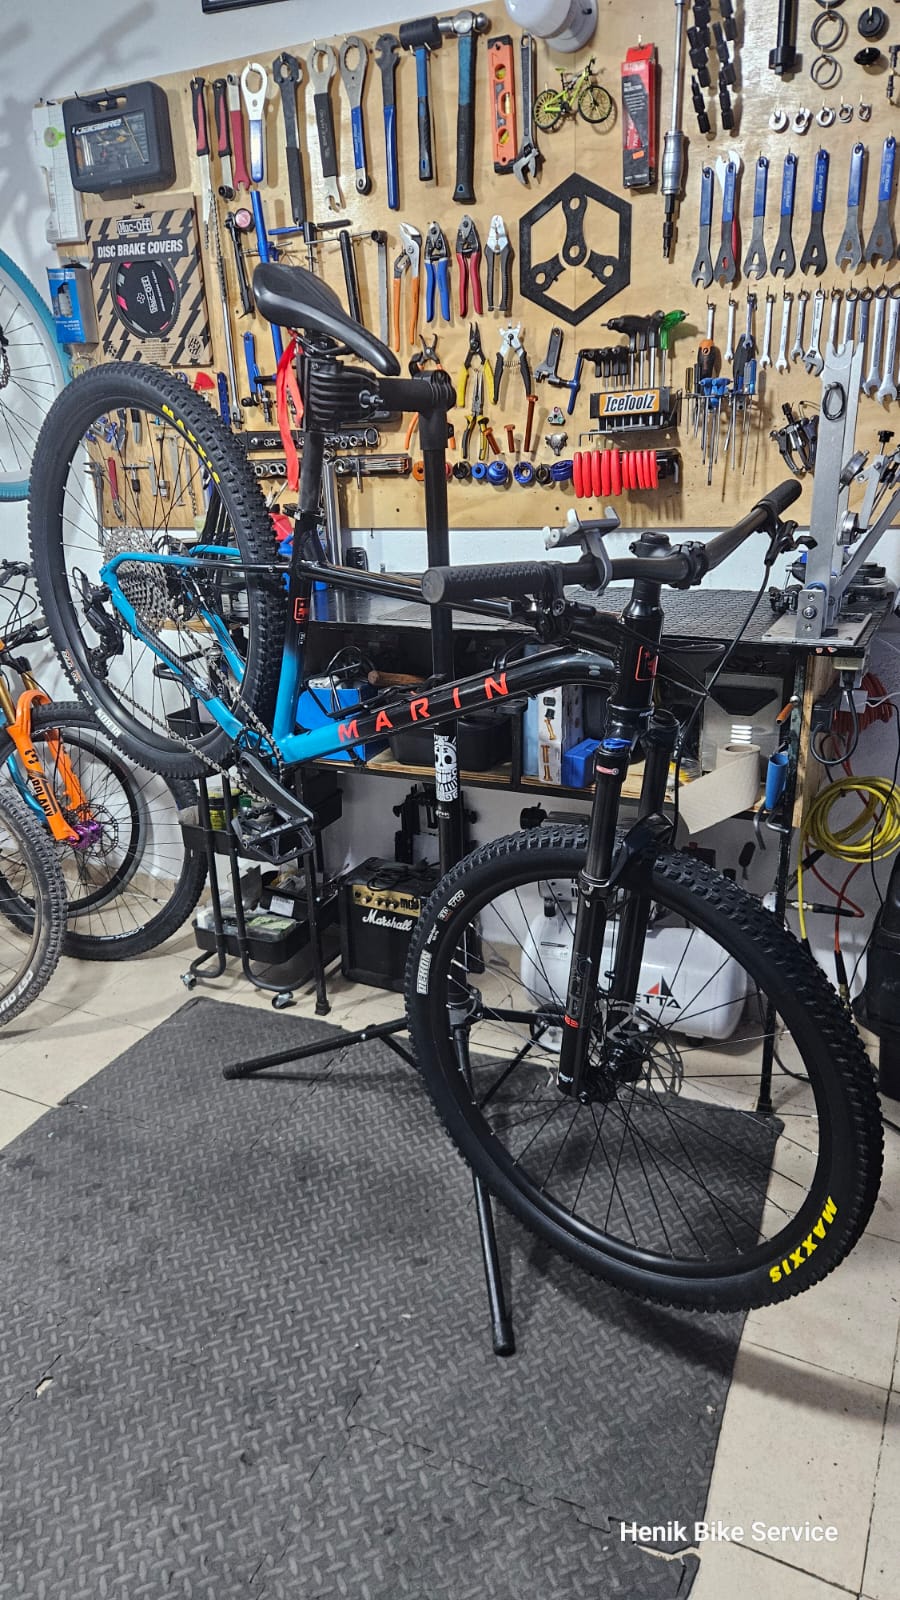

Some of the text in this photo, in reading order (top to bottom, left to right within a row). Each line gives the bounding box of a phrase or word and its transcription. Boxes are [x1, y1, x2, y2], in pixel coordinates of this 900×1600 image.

[97, 239, 183, 258] DISC BRAKE COVERS
[604, 393, 656, 413] IceToolz
[161, 404, 221, 484] MAXXIS
[337, 672, 509, 743] MARIN
[362, 908, 413, 932] Marshall
[635, 992, 682, 1009] ETTA
[769, 1195, 838, 1284] MAXXIS
